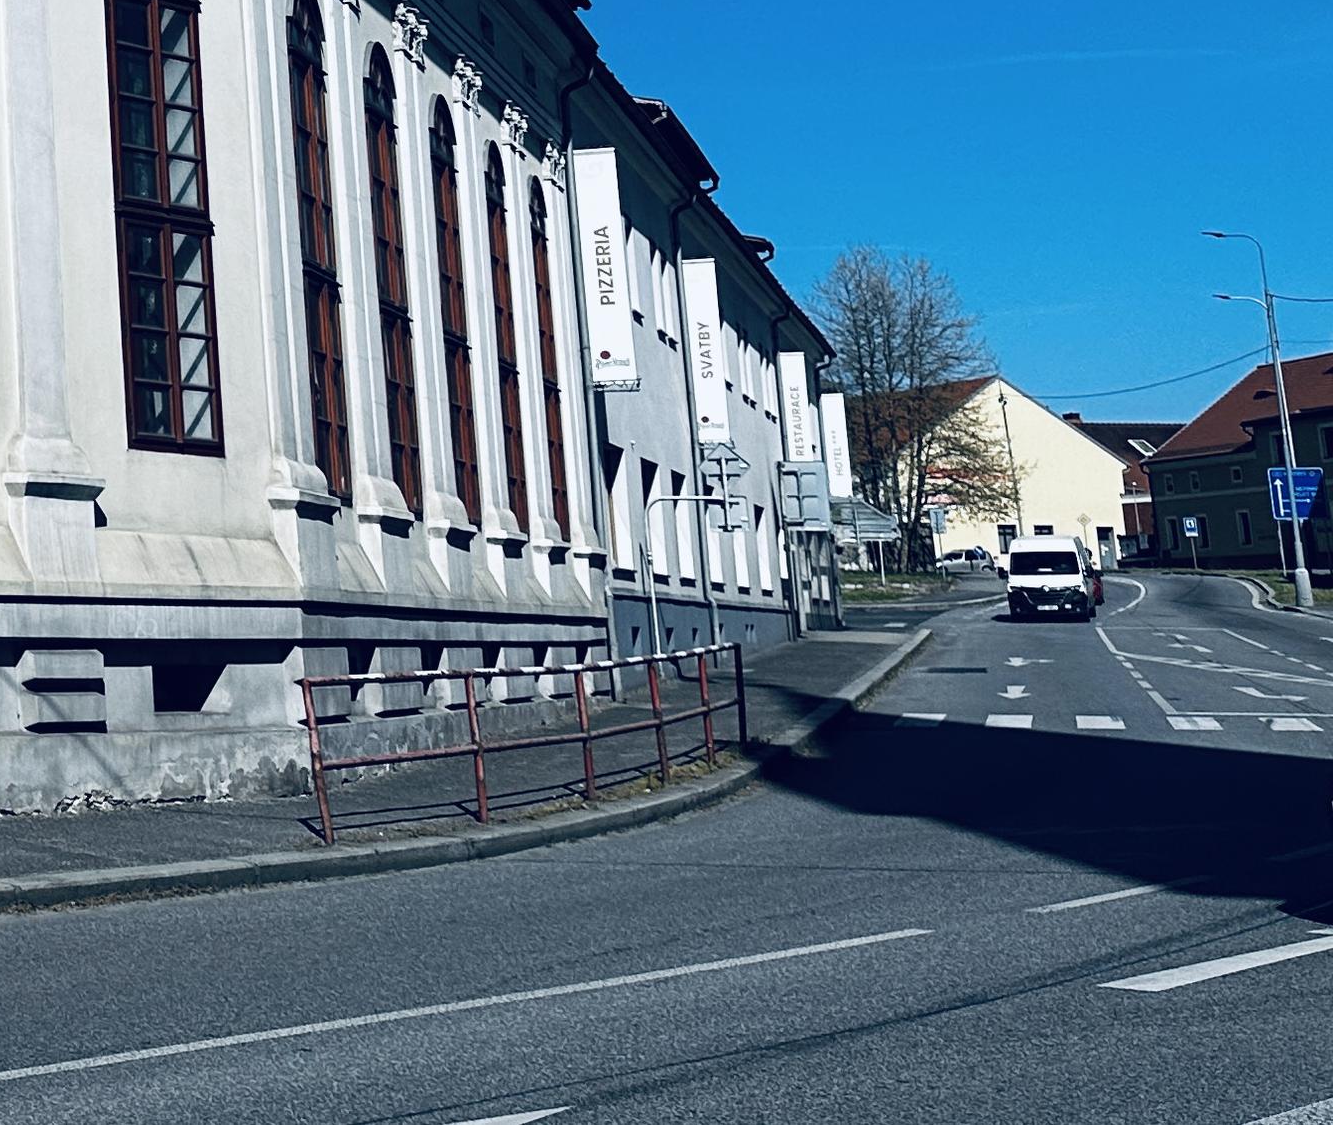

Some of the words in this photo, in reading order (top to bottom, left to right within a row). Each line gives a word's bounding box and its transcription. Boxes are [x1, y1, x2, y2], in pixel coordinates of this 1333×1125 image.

[594, 225, 616, 306] PIZZERIA
[696, 321, 714, 379] SVATBY
[789, 386, 805, 457] RESTAURACE
